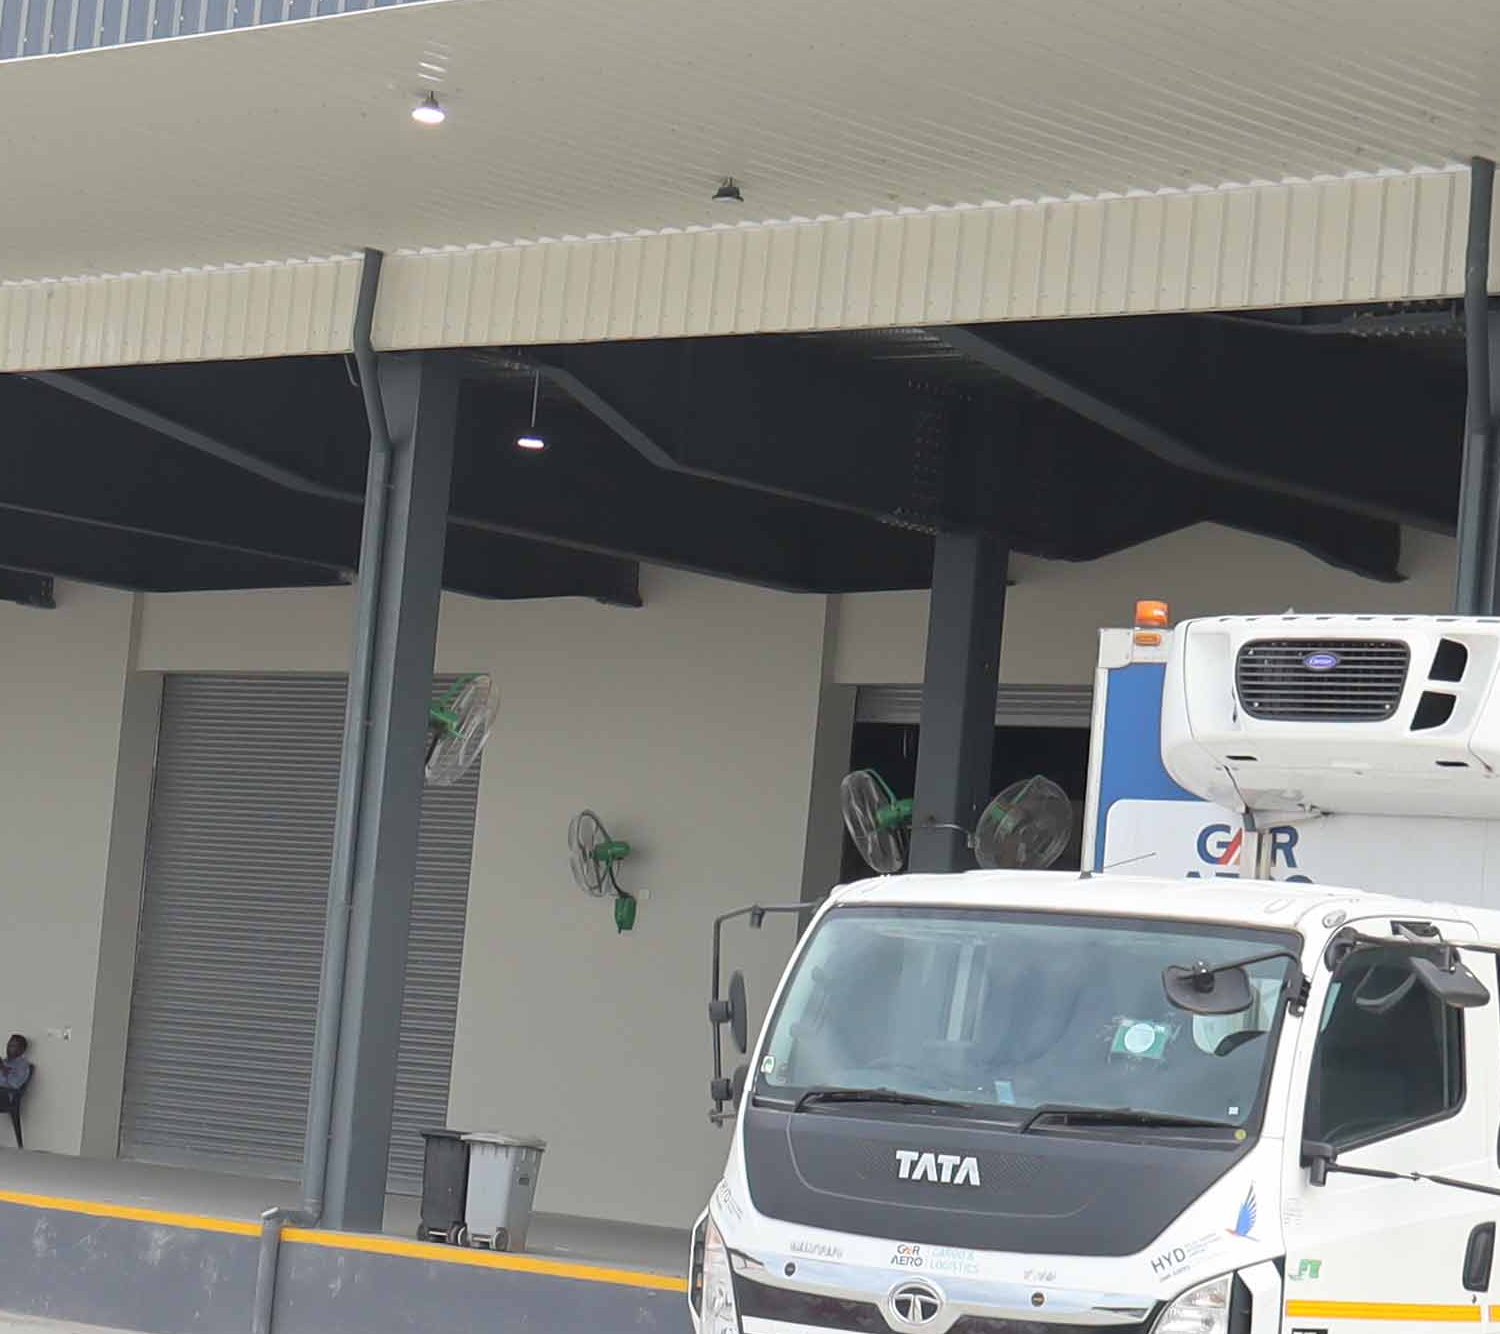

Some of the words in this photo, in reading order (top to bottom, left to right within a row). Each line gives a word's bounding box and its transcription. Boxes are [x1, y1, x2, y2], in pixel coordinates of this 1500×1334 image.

[1196, 823, 1299, 869] GR
[895, 1149, 982, 1187] TATA
[890, 1254, 924, 1268] AERO
[1150, 1247, 1187, 1274] HYD
